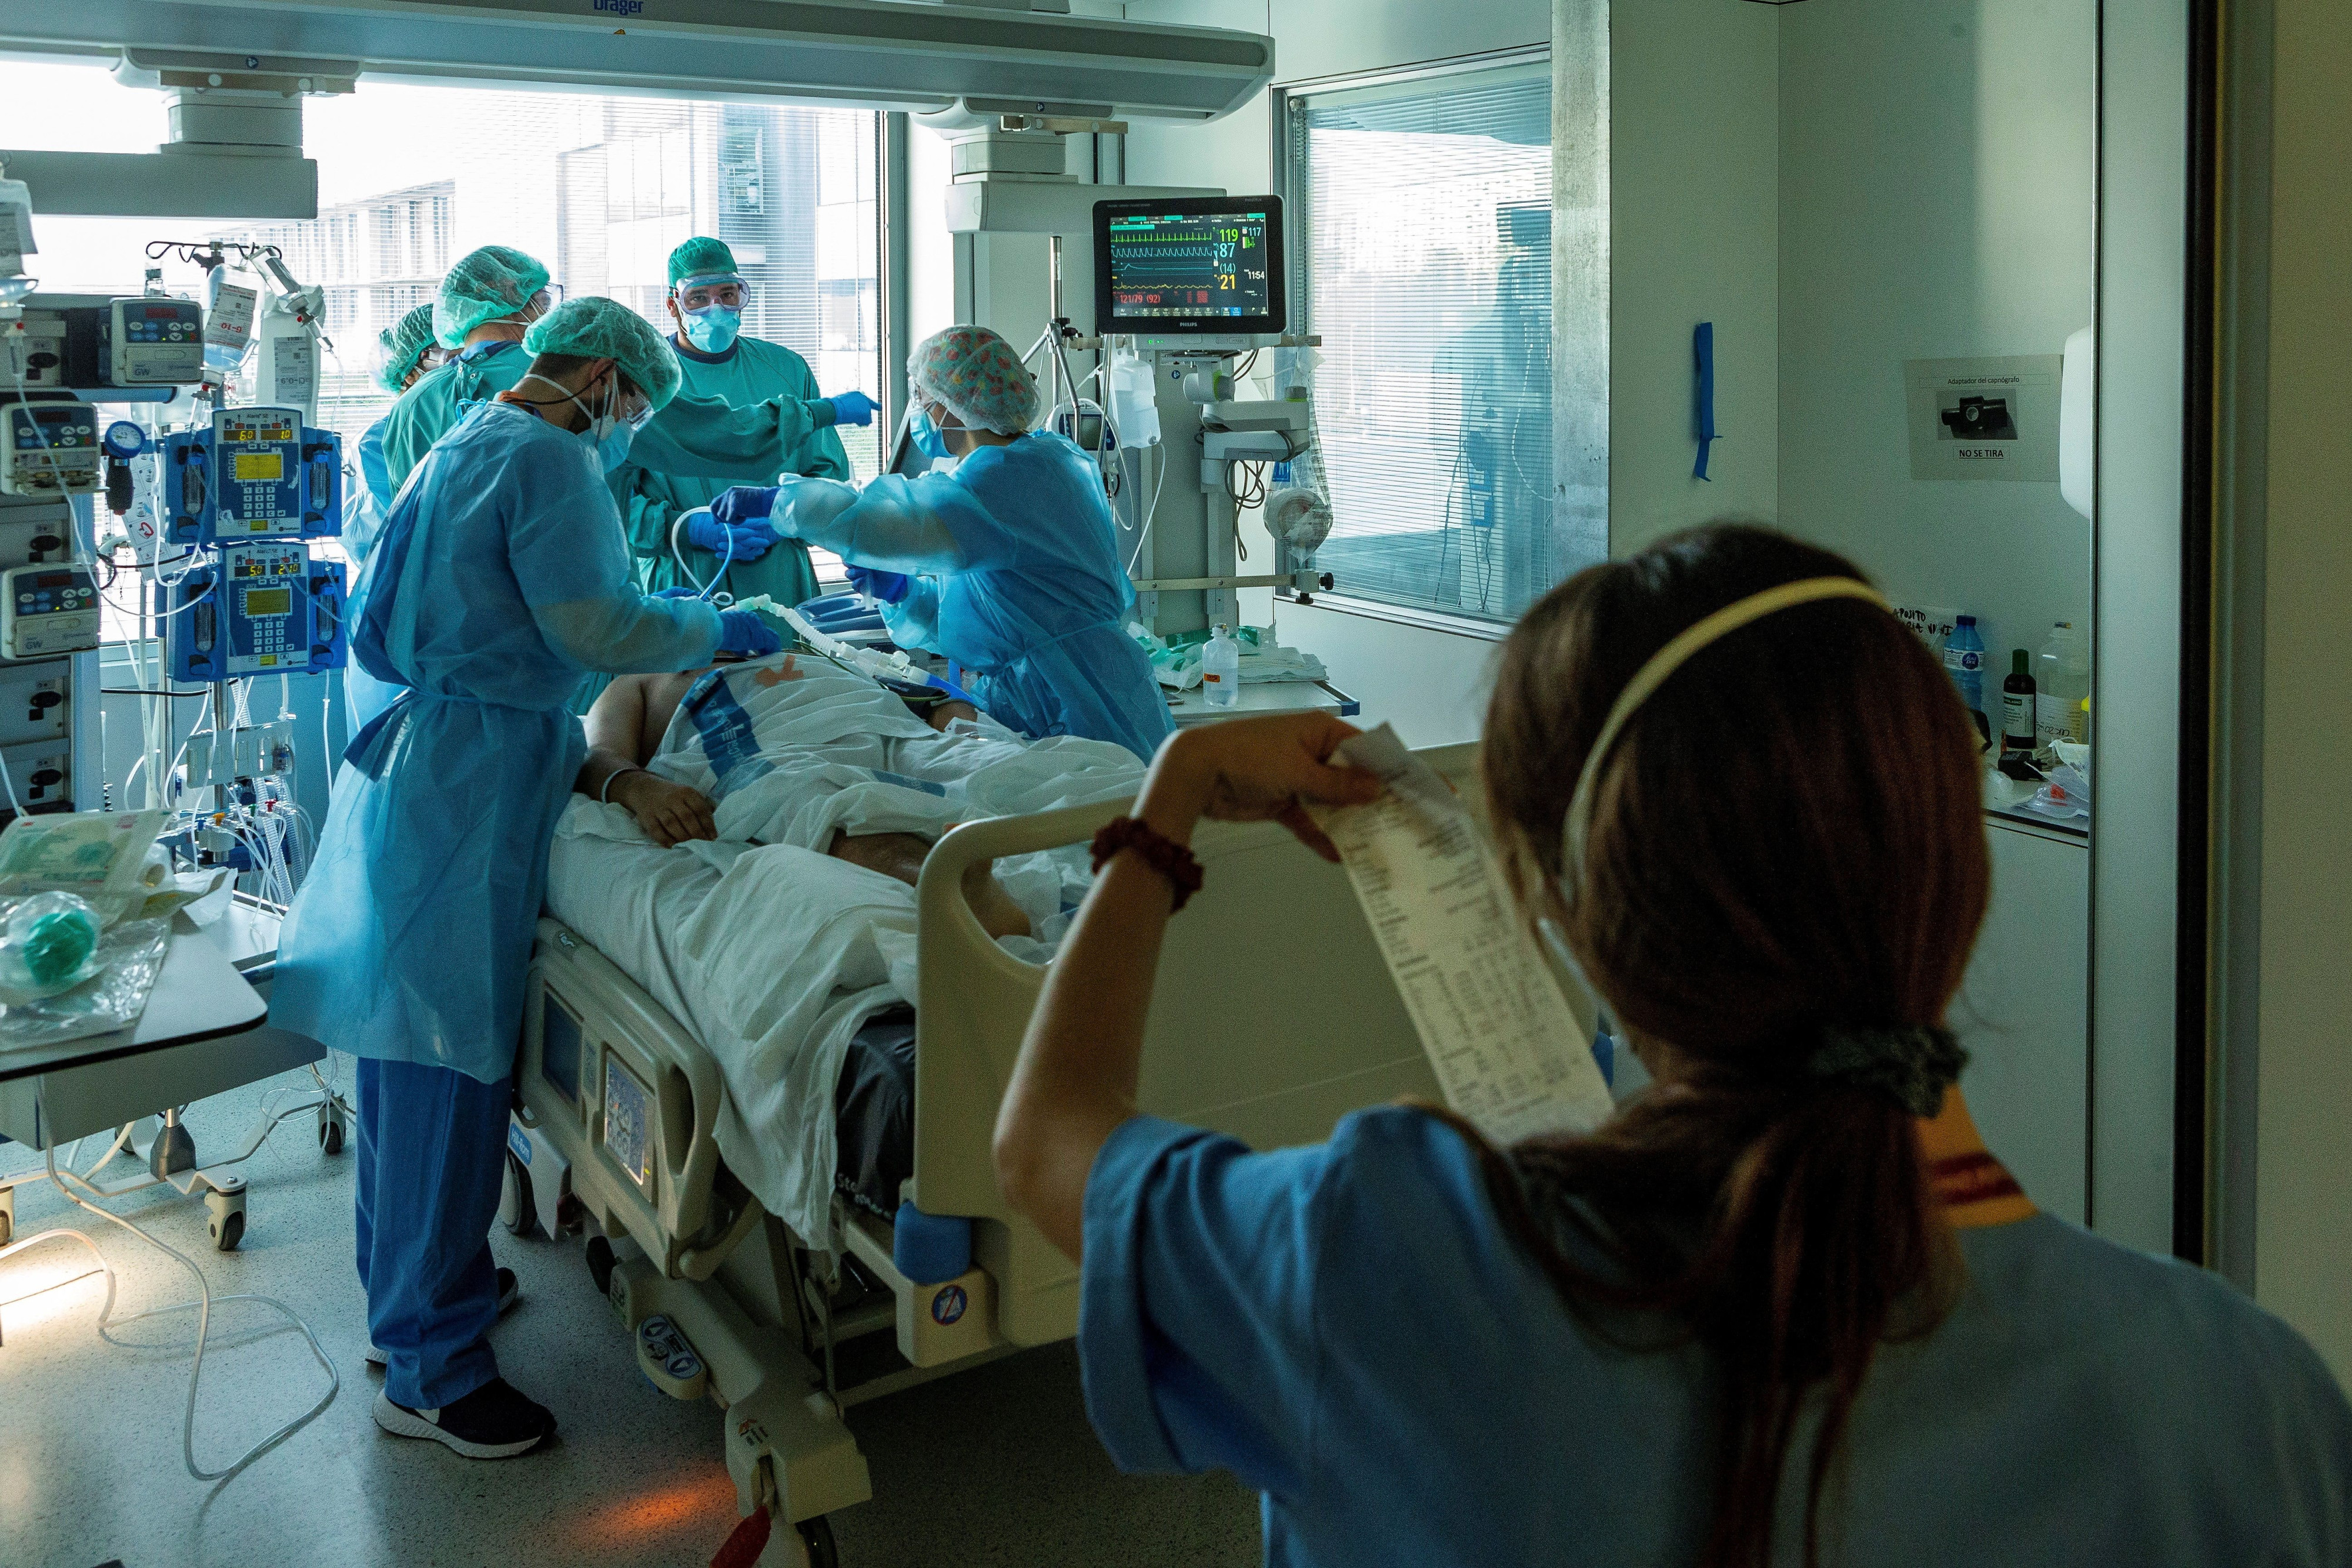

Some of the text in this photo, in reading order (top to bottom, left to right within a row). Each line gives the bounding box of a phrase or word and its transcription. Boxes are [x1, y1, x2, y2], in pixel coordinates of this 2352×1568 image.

[1220, 227, 1261, 242] 119 117
[1220, 242, 1235, 258] 87
[1220, 263, 1236, 274] (14)
[1220, 274, 1236, 290] 21
[1987, 376, 2020, 384] capnógrafo
